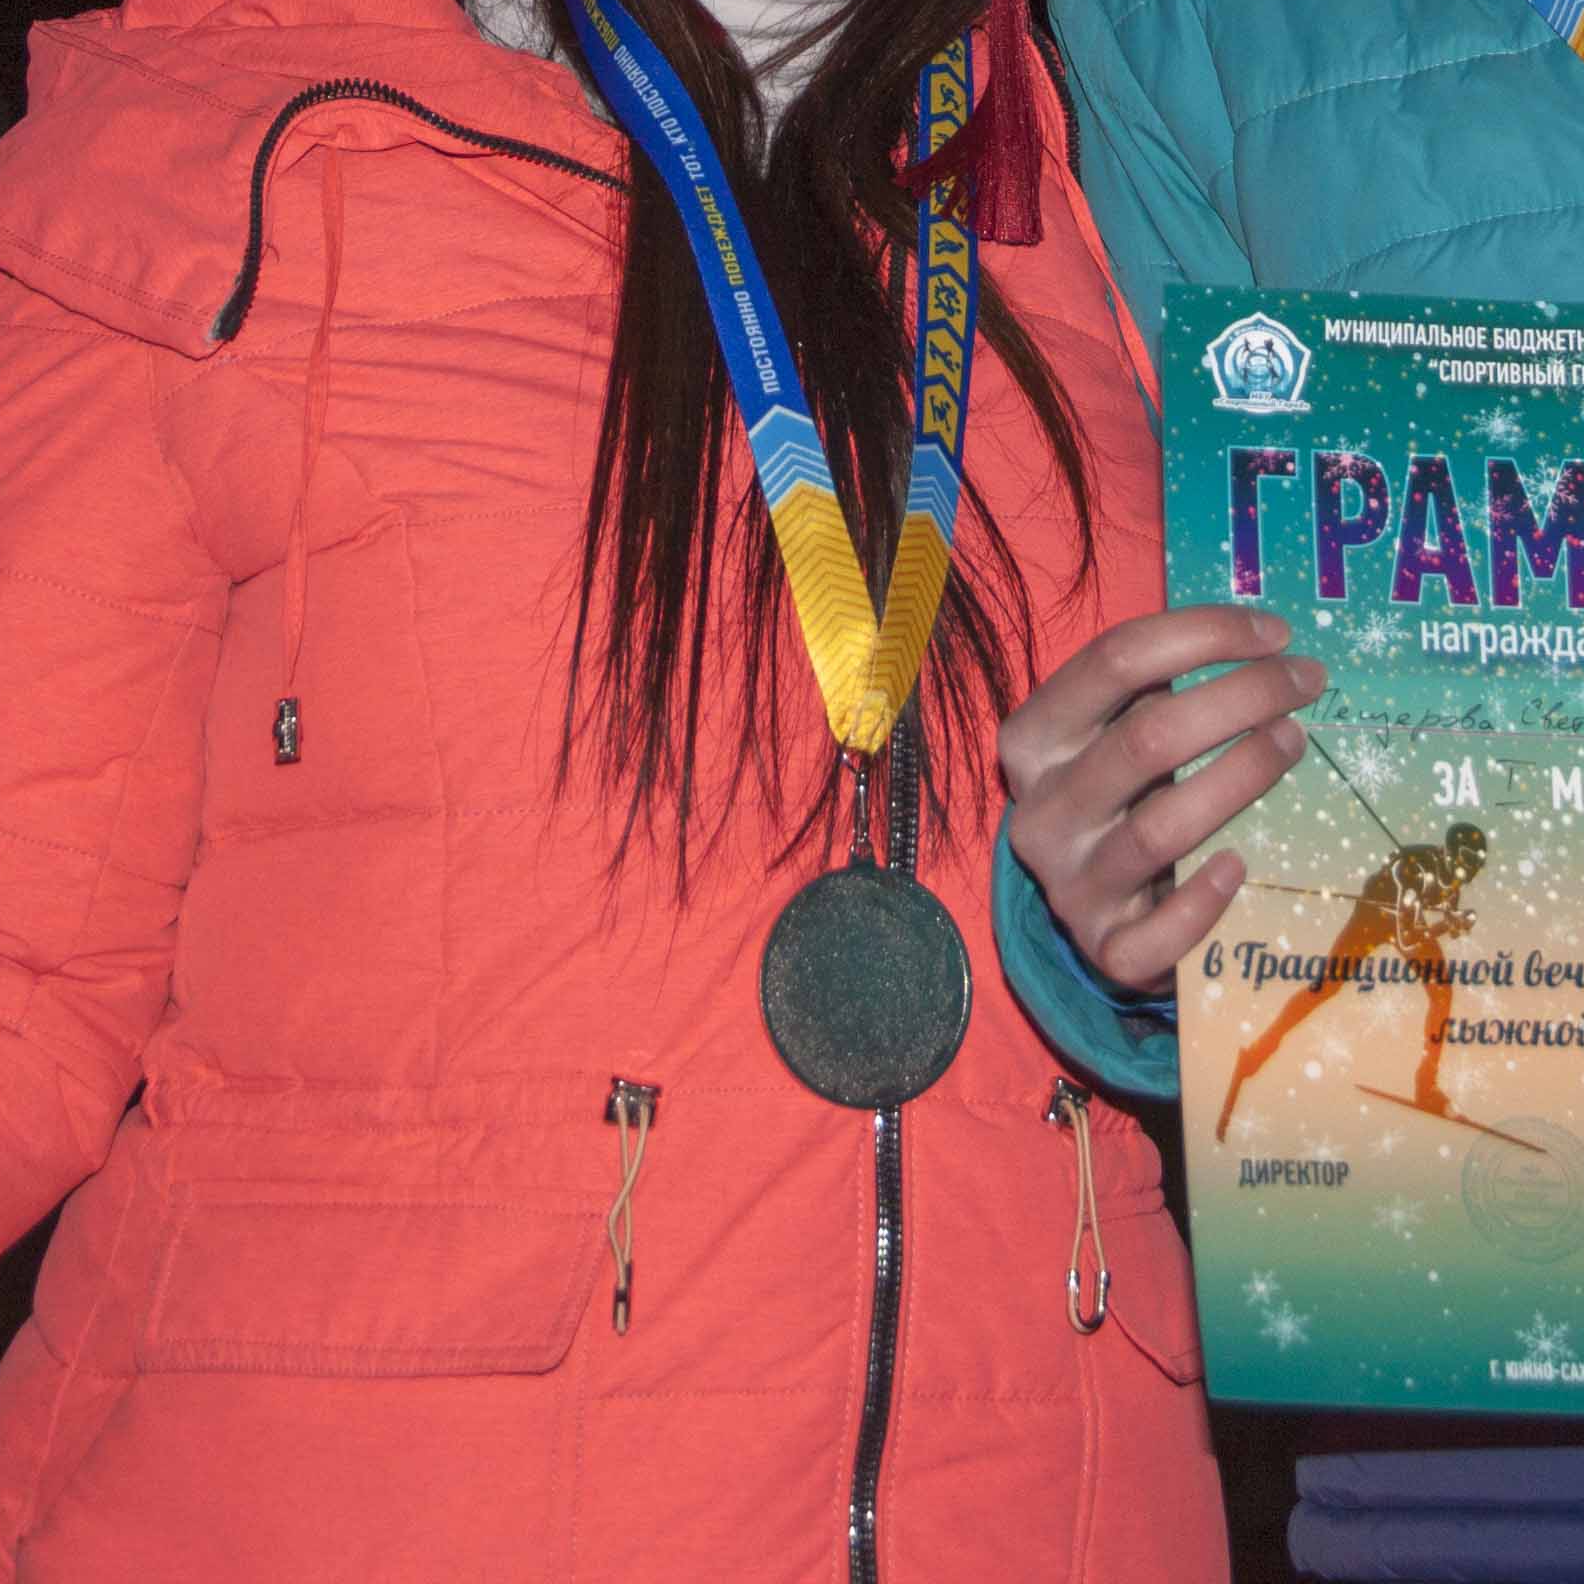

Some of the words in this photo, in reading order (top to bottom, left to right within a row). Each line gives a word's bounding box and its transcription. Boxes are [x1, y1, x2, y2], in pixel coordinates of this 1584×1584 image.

[613, 43, 672, 124] ПОСТОЯННО
[661, 114, 690, 148] КТО
[678, 144, 706, 182] ТОТ,
[693, 184, 746, 287] ПОБЕЖДАЕТ
[732, 288, 779, 394] ПОСТОЯННО
[1324, 318, 1487, 351] МУНИЦИПАЛЬНОЕ
[1432, 760, 1481, 808] ЗА
[1203, 942, 1225, 978] в
[1233, 940, 1514, 990] Традиционной
[1238, 1158, 1350, 1188] ДИРЕКТОР
